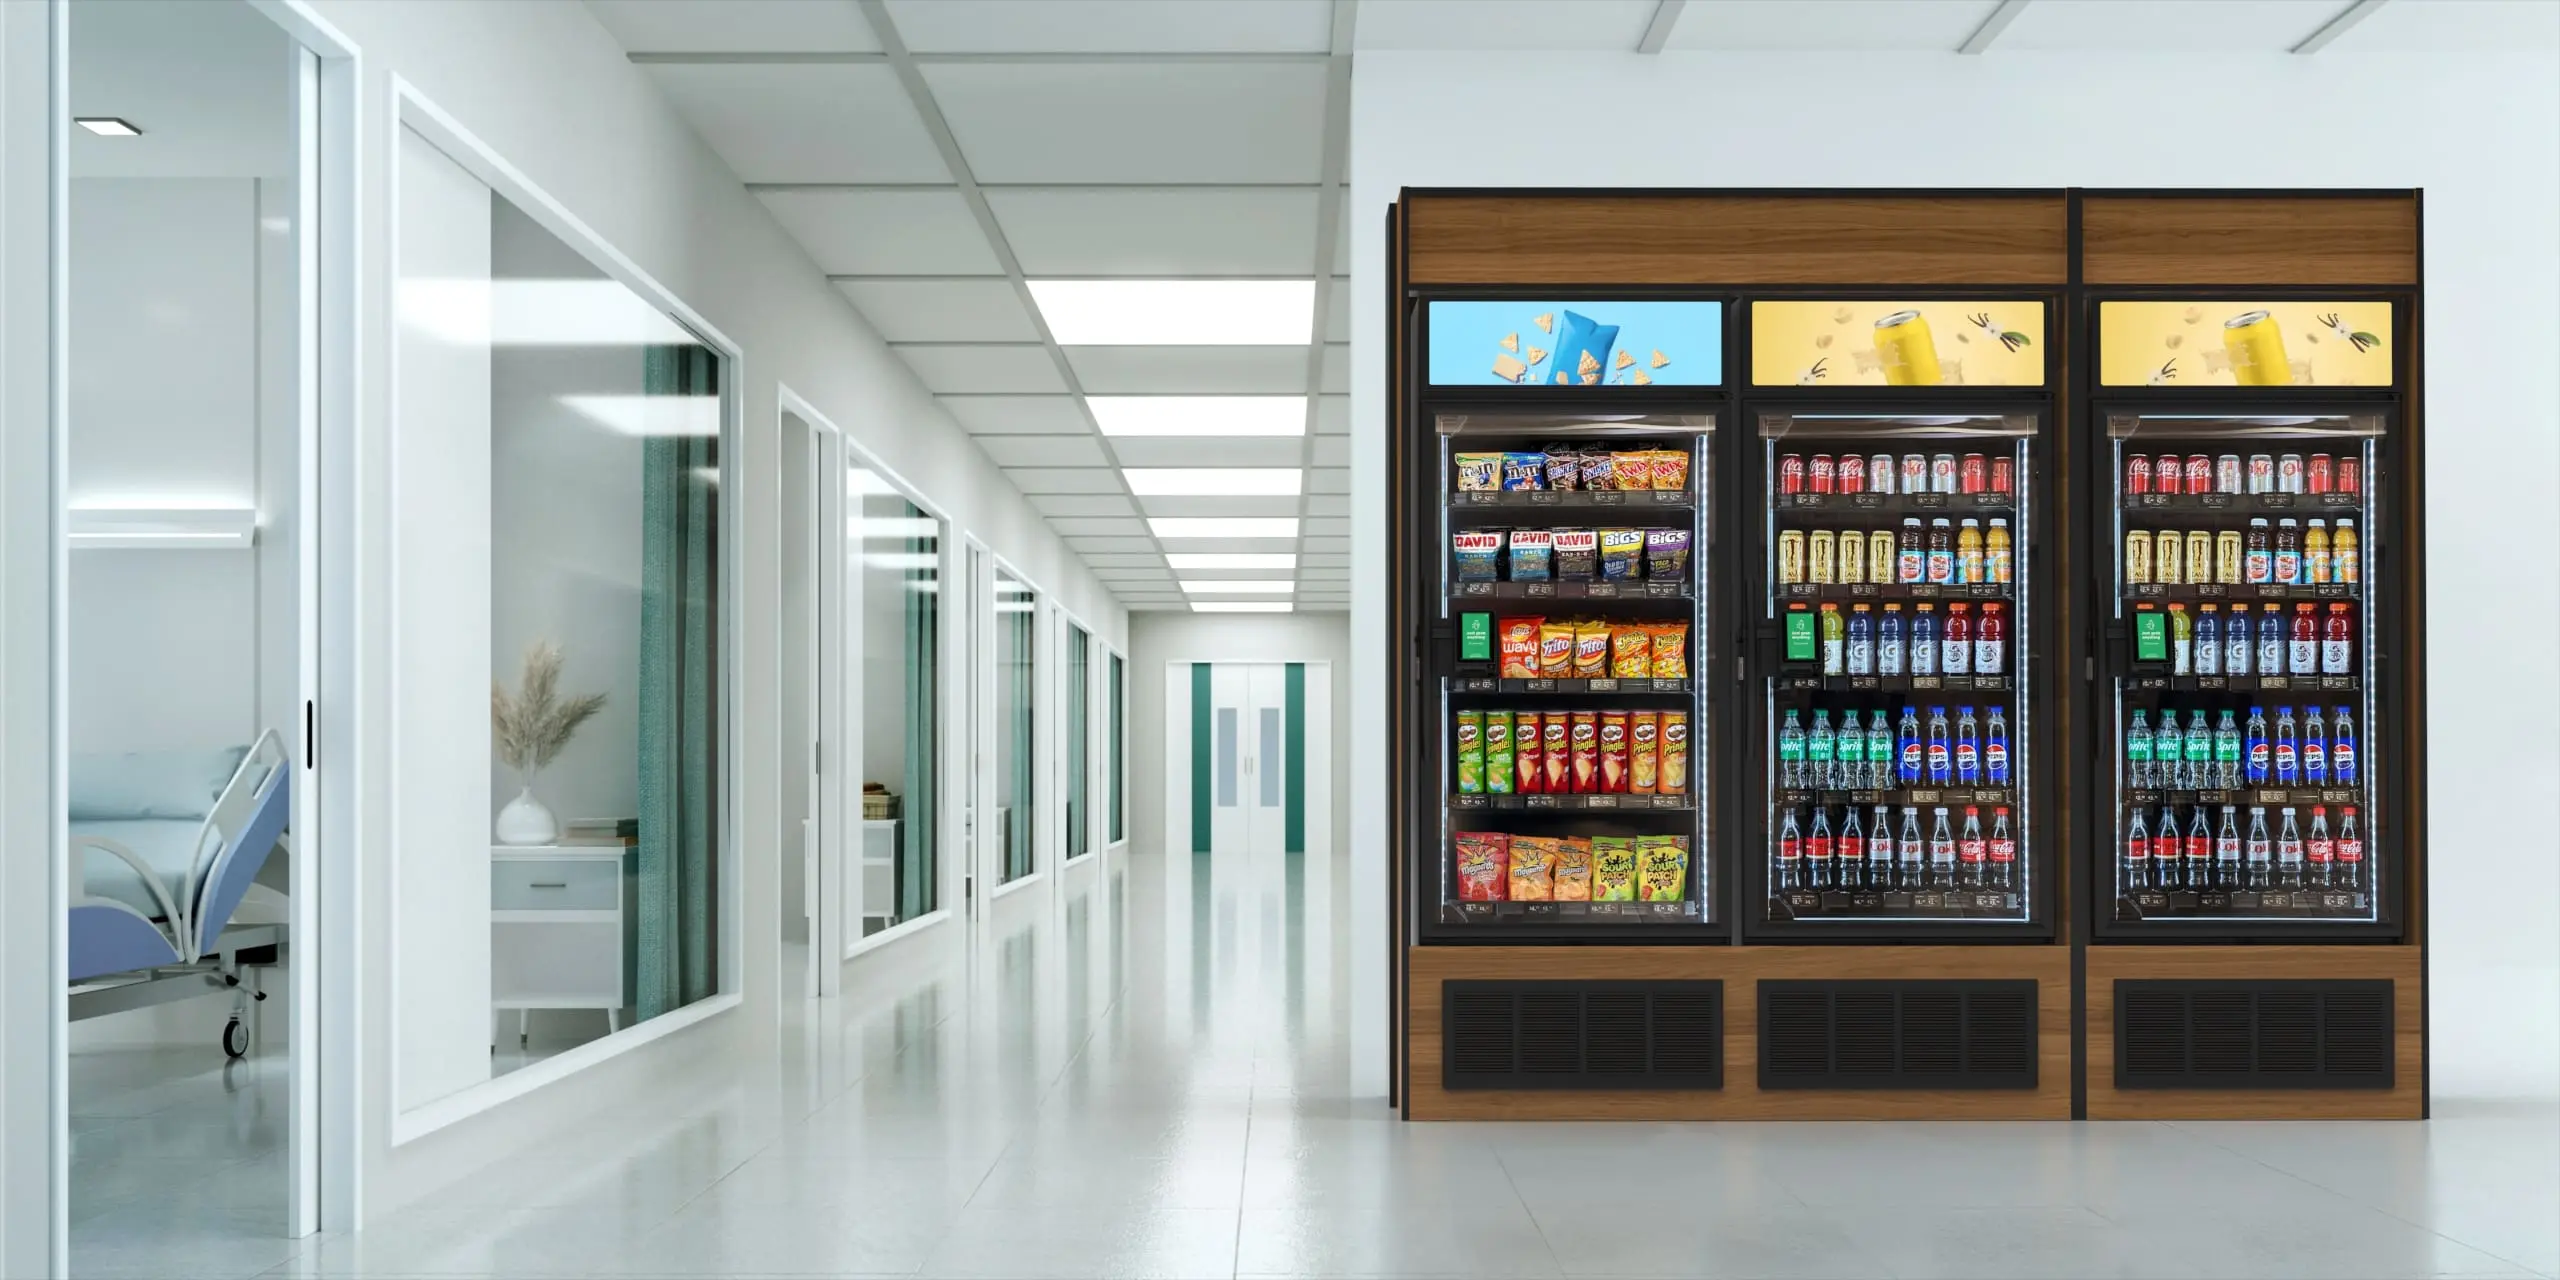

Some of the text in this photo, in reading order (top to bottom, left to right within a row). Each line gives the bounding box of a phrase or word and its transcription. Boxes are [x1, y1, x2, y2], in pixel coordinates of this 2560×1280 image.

[1455, 536, 1497, 547] DAVID
[1512, 533, 1550, 544] DAVID
[1555, 534, 1592, 546] DAVID
[1503, 640, 1537, 655] wavy
[1648, 862, 1677, 872] SOUR
[1601, 871, 1630, 881] PATCH
[1647, 871, 1677, 881] PATCH
